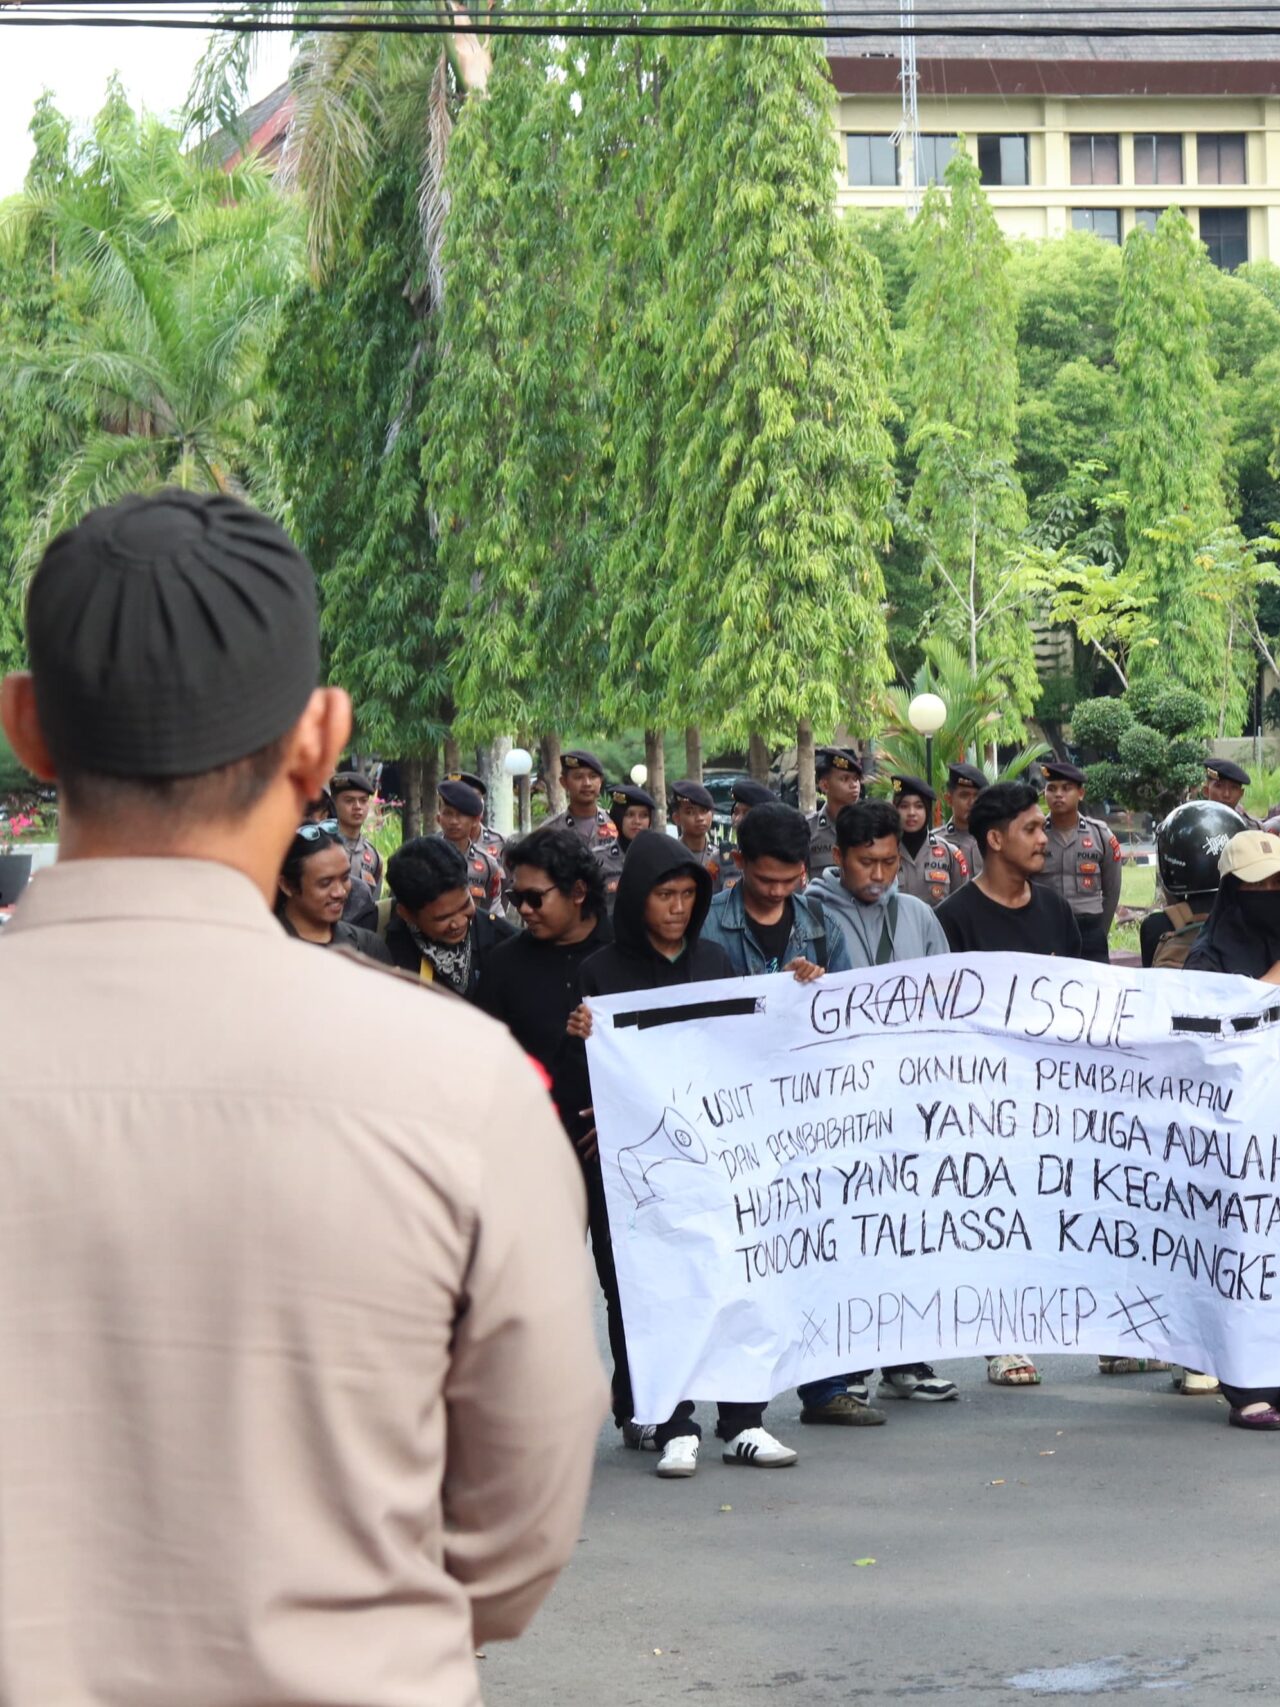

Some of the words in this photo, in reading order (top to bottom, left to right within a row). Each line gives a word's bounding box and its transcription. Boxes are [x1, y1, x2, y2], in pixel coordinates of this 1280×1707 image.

[924, 861, 951, 871] POLRI
[811, 968, 985, 1035] GRAND
[1004, 973, 1142, 1051] ISSUE
[702, 1083, 755, 1128] USUT
[770, 1059, 875, 1107] TUNTAS
[899, 1056, 1008, 1086] OKNUM
[1036, 1057, 1234, 1113] PEMBAKARAN
[717, 1143, 761, 1182] DAN
[766, 1107, 893, 1167] PEMBABATAN
[915, 1098, 1017, 1142] YANG
[1033, 1101, 1060, 1139] DI
[1072, 1109, 1153, 1157] DUGA
[734, 1166, 823, 1236] HUTAN
[831, 1152, 920, 1206] YANG
[931, 1151, 1017, 1199] ADA
[1037, 1153, 1073, 1197] DI
[735, 1218, 839, 1283] TONDONG
[852, 1206, 1032, 1258] TALLASSA
[954, 1284, 1098, 1347] PANGKEP
